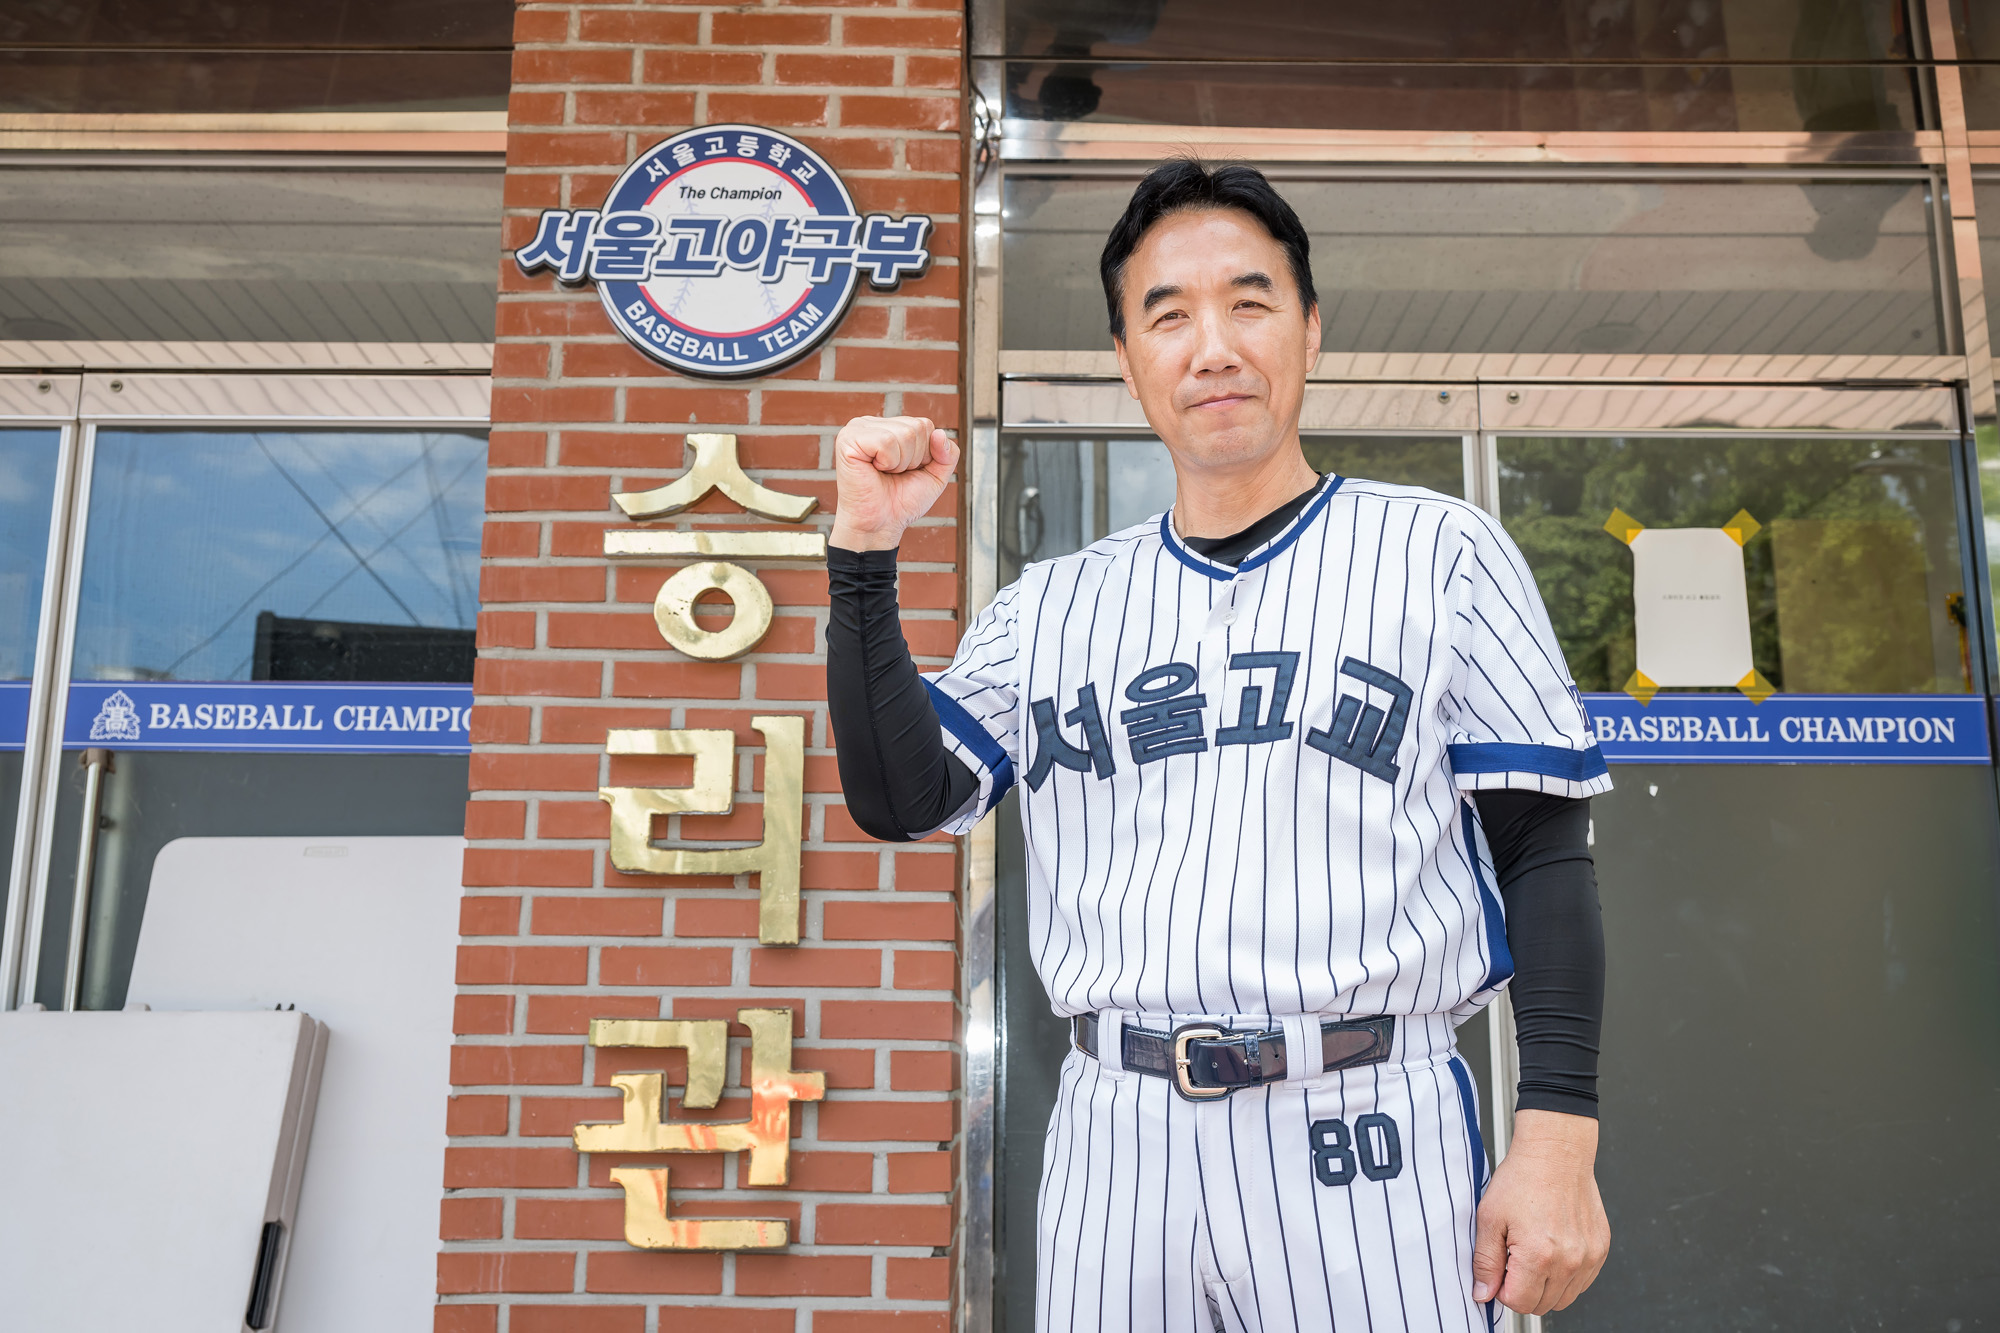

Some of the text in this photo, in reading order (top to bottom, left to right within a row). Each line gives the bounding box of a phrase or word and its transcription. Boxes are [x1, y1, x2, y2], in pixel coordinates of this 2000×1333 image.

[645, 135, 818, 186] 서울고등학교
[679, 186, 782, 201] The Champion
[518, 212, 929, 283] 서울고야구부
[625, 300, 824, 361] BASEBALL TEAM
[147, 703, 324, 731] BASEBALL
[1023, 651, 1415, 794] 서울고교
[1593, 716, 1956, 743] BASEBALL CHAMPION
[573, 433, 828, 1251] 승리관
[1310, 1112, 1402, 1187] 80
